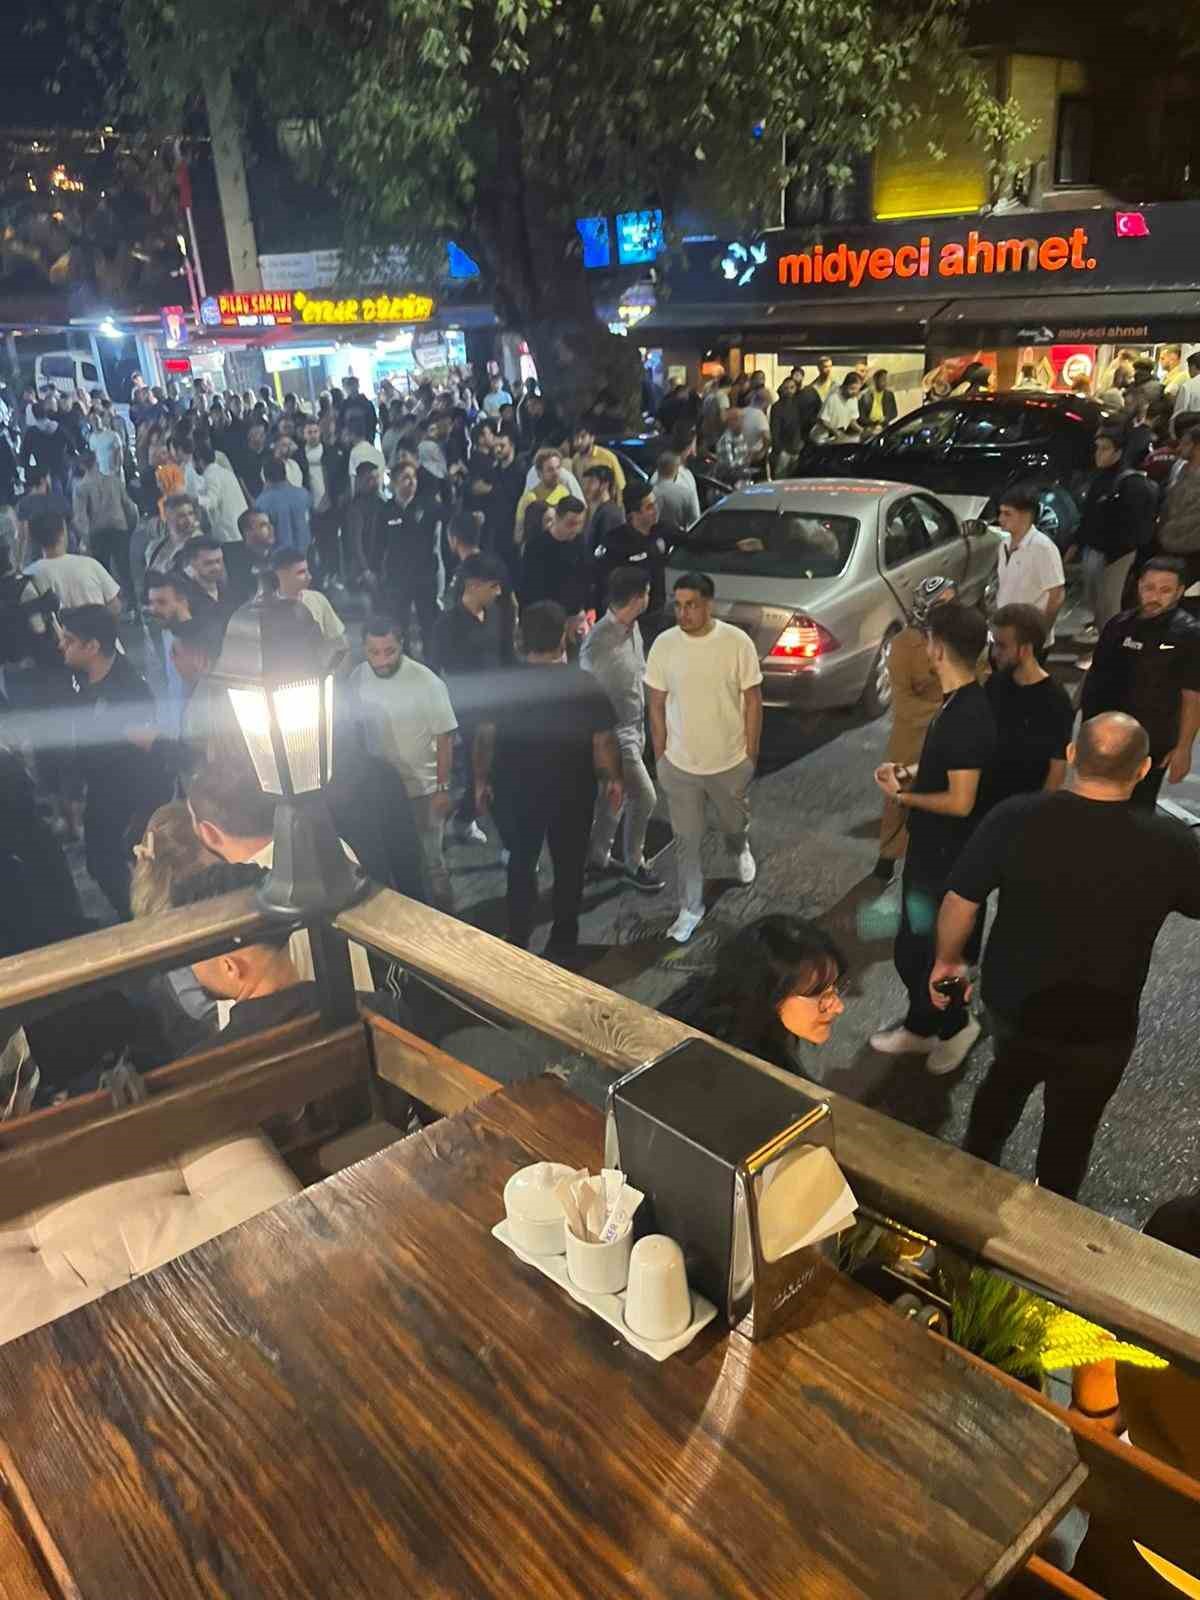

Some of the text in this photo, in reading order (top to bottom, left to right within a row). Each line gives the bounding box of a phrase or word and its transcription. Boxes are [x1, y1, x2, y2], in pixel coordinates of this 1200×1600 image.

[778, 227, 1098, 288] midyeci ahmet.
[1057, 327, 1106, 341] midyeci
[1107, 325, 1149, 337] ahmet
